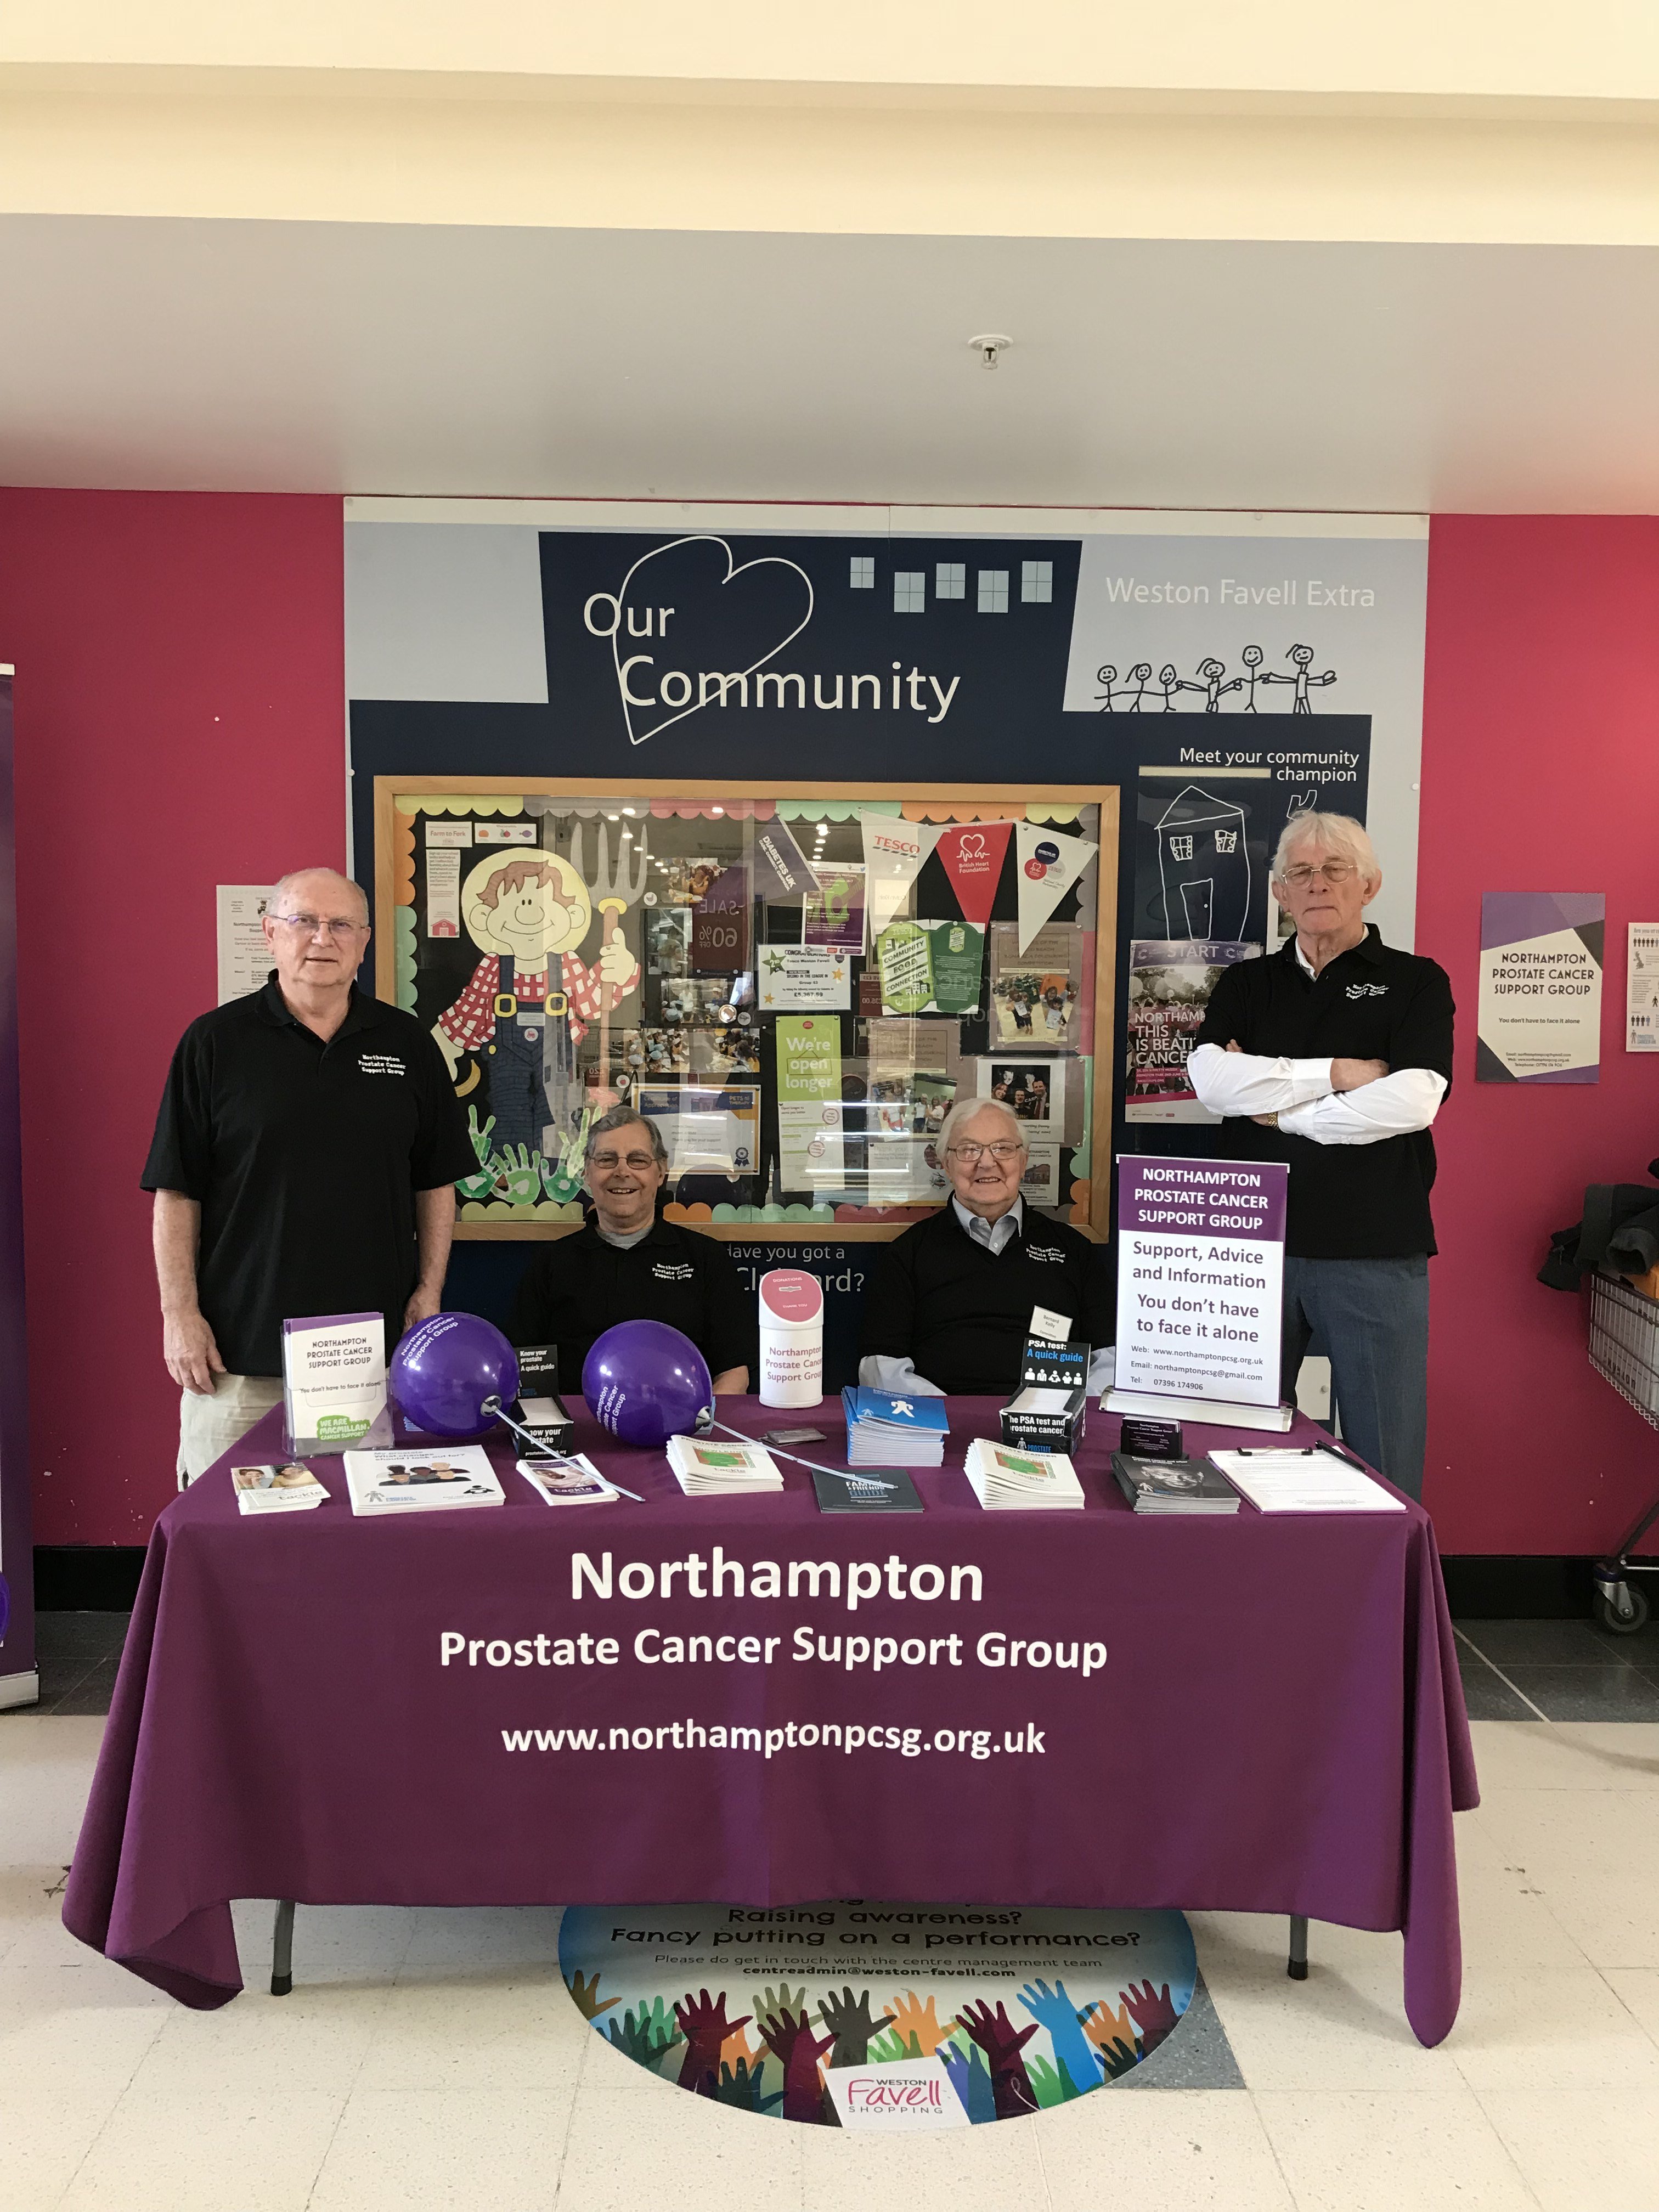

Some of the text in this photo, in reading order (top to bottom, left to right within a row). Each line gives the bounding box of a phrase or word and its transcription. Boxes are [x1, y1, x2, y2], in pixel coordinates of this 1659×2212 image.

[1106, 577, 1375, 607] Weston Favell Extra
[583, 594, 675, 637] Our
[619, 656, 961, 723] Community
[1180, 747, 1360, 768] Meet your community
[1276, 767, 1357, 786] champion
[874, 835, 921, 854] TESCO
[785, 874, 797, 889] UK
[884, 940, 924, 964] COMMUNITY
[1167, 945, 1219, 958] START
[1502, 953, 1587, 964] NORTHAMPTON
[893, 958, 918, 974] FOOD
[1492, 968, 1595, 980] PROSTATE CANCER
[886, 968, 928, 992] CONNECTION
[1494, 984, 1591, 995] SUPPORT GROUP
[1135, 1011, 1206, 1023] NORTHAMP
[1135, 1025, 1169, 1037] THIS
[786, 1036, 831, 1051] We're
[1136, 1037, 1196, 1051] IS BEATI
[362, 1054, 400, 1062] Northampton
[1136, 1052, 1188, 1064] CANCE
[790, 1059, 827, 1074] open
[786, 1074, 833, 1092] longer
[1142, 1167, 1261, 1187] NORTHAMPTON
[1134, 1188, 1269, 1209] PROSTATE CANCER
[1138, 1209, 1263, 1230] SUPPORT GROUP
[766, 1246, 797, 1262] you
[802, 1245, 832, 1262] got
[836, 1248, 845, 1259] a
[1133, 1240, 1264, 1265] Support, Advice
[1132, 1266, 1266, 1289] and Information
[1137, 1293, 1260, 1318] You don't have
[401, 1317, 444, 1356] Northampton
[1137, 1318, 1259, 1343] to face it alone
[312, 1337, 367, 1348] NORTHAMPTON
[402, 1317, 455, 1367] Prostate Cancer
[414, 1322, 459, 1362] upport Group
[1028, 1339, 1067, 1350] PSA test:
[307, 1346, 373, 1359] PROSTATE CANCER
[769, 1346, 821, 1357] Northampton
[1026, 1348, 1084, 1362] A quick guide
[1131, 1345, 1263, 1366] Web: www.northamptonpcsg.org.uk
[308, 1357, 371, 1369] SUPPORT GROUP
[520, 1356, 543, 1364] prostate
[526, 1364, 540, 1372] quick
[540, 1363, 555, 1372] guide
[765, 1358, 800, 1369] Prostate
[767, 1371, 802, 1383] Support
[1131, 1361, 1263, 1382] Email: northamptonpcsg@gmail.com
[1130, 1376, 1204, 1391] Tel: 07396 174906
[604, 1385, 619, 1413] Cancer
[612, 1393, 627, 1417] Group
[1009, 1415, 1065, 1426] he PSA test and
[341, 1431, 365, 1439] SUPPORT
[544, 1429, 562, 1437] your
[1038, 1426, 1063, 1435] cancer
[570, 1546, 984, 1611] Northampton
[439, 1626, 1109, 1677] Prostate Cancer Support Group
[500, 1718, 1047, 1760] www.northamptonpcsg.org.uk
[727, 1909, 1023, 1926] Raising awareness?
[611, 1928, 1142, 1949] Fancy putting on a performance?
[654, 1954, 1103, 1968] Please do get in touch with the centre management team
[743, 1966, 1016, 1977] centreadmin@weston-favell.com
[848, 2078, 942, 2107] Favell
[848, 2106, 944, 2114] SHOPPING
